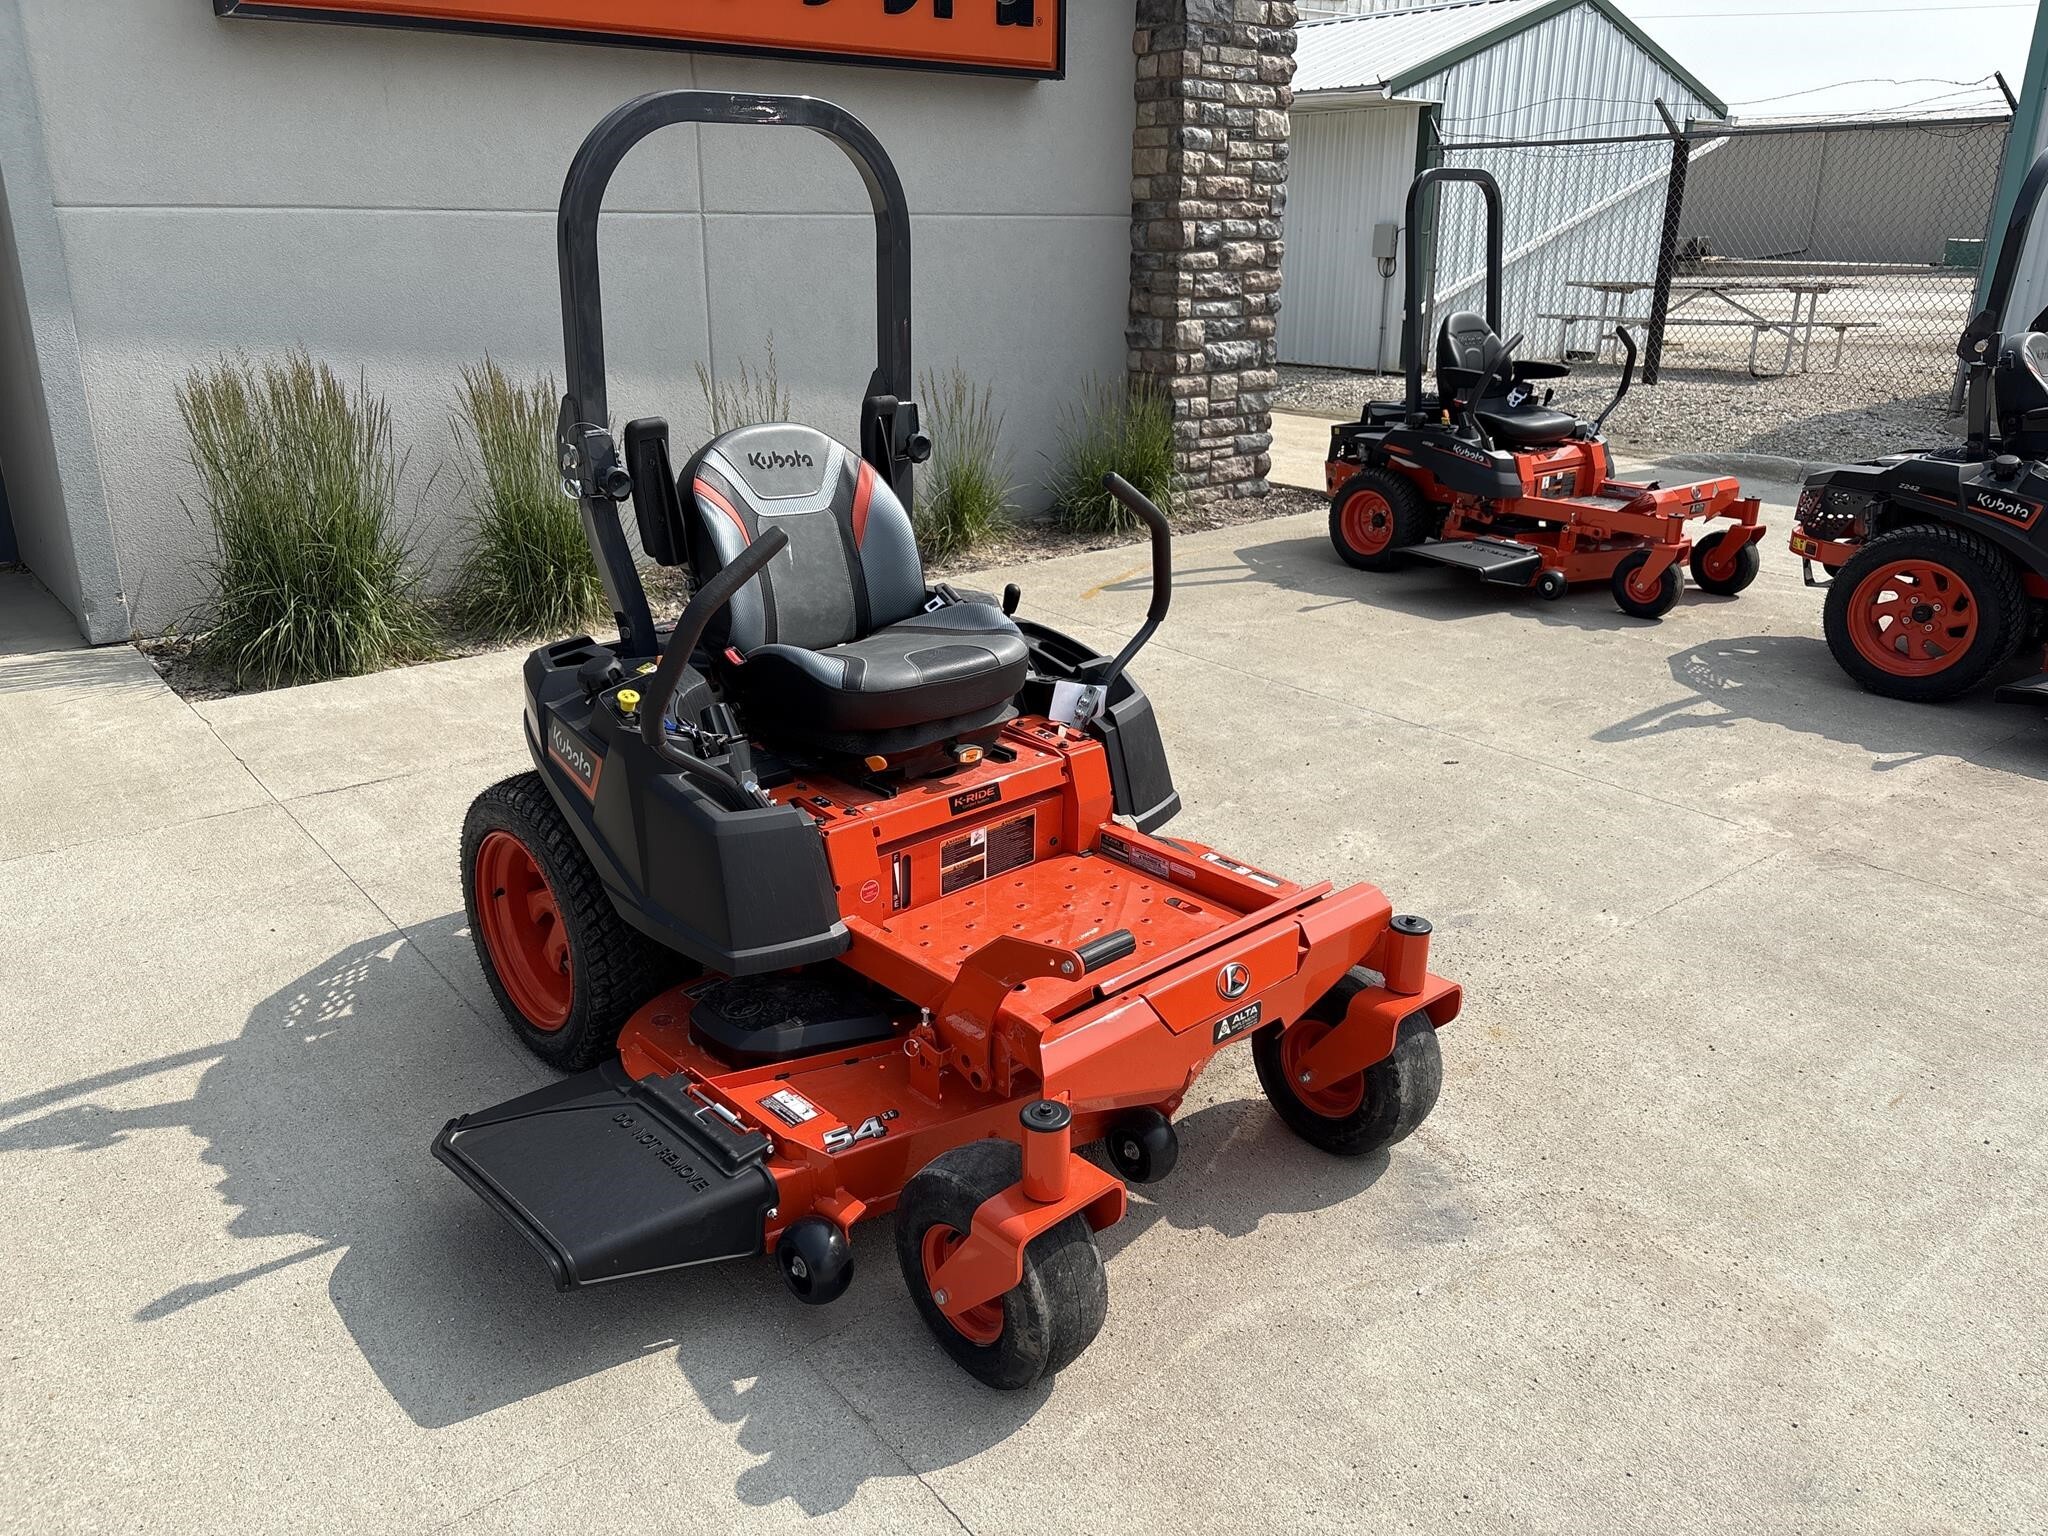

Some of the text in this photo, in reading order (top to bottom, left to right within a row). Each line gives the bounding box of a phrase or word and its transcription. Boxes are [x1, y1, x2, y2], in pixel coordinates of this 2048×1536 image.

[747, 449, 814, 470] Kubota
[1453, 444, 1485, 462] Kubota
[1977, 492, 2030, 519] Kubota
[552, 725, 592, 779] Kubota
[953, 786, 997, 808] K-RIDE
[1231, 1005, 1258, 1025] ALTA
[612, 1112, 711, 1194] DO NOT REMOVE
